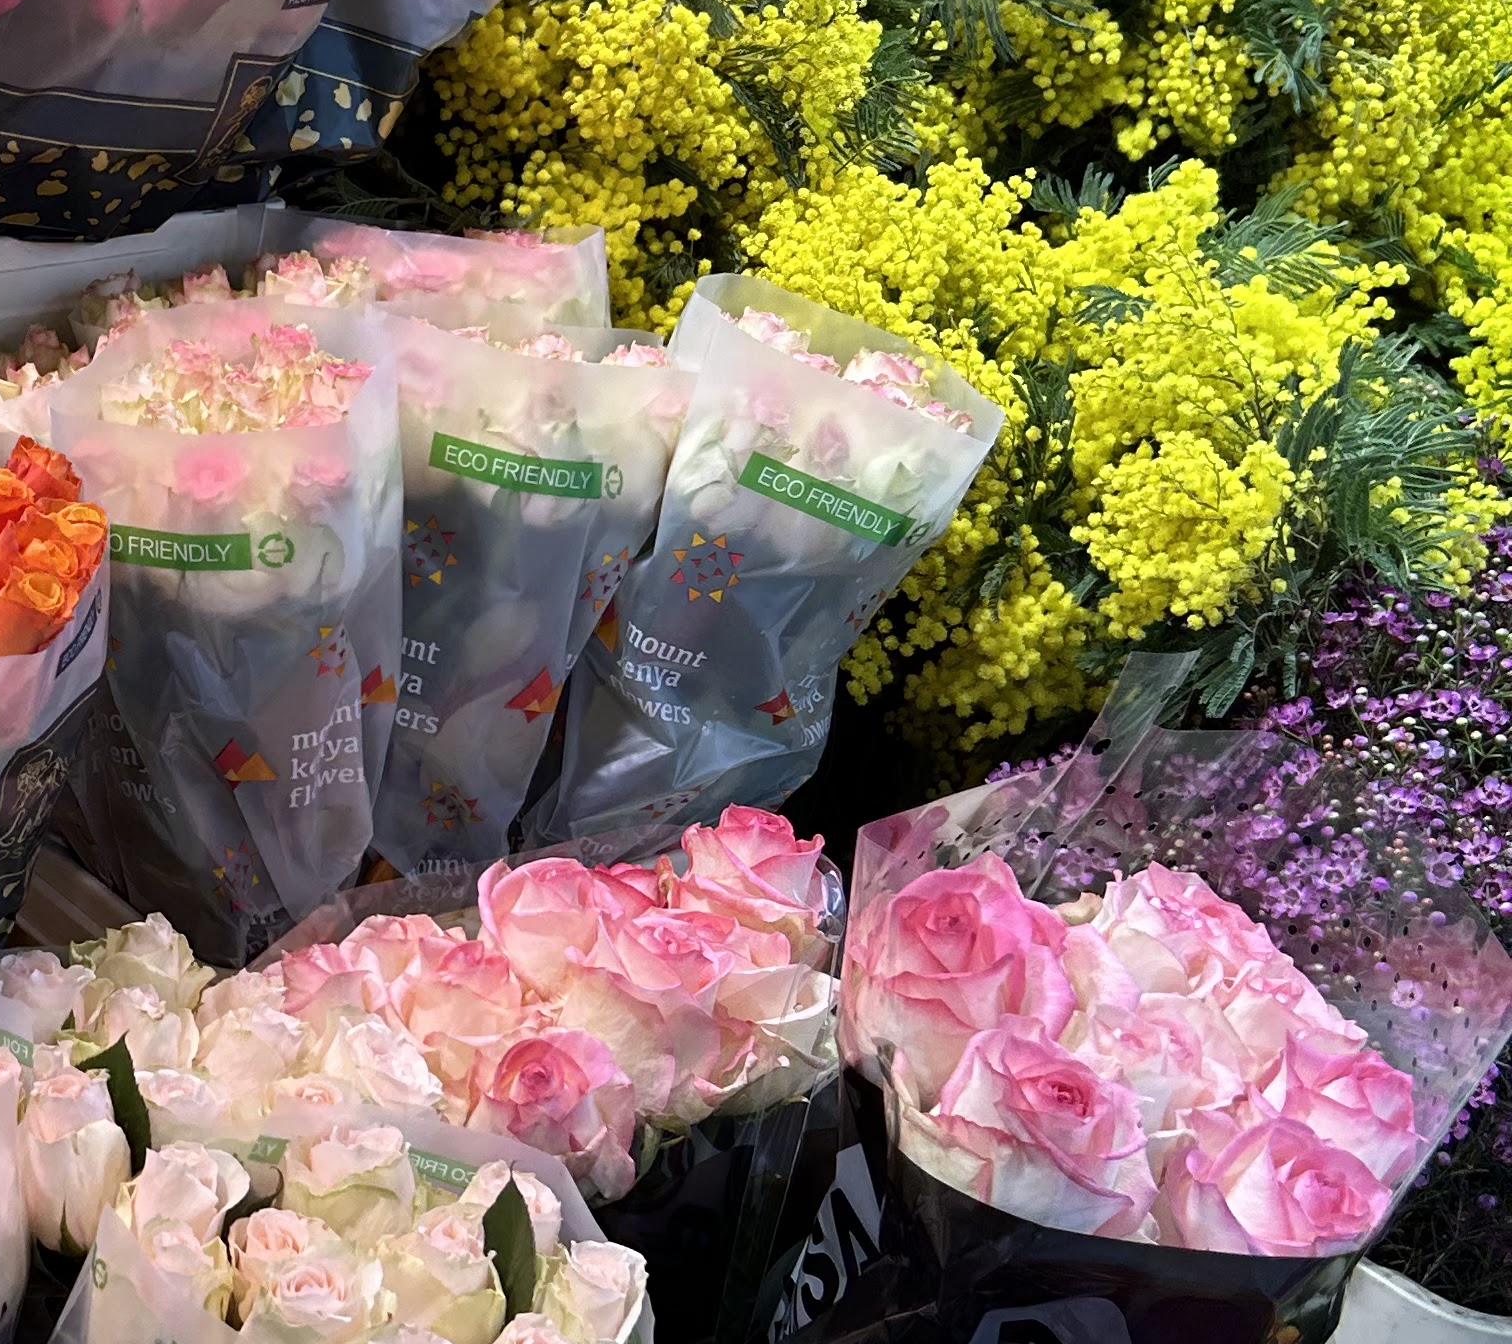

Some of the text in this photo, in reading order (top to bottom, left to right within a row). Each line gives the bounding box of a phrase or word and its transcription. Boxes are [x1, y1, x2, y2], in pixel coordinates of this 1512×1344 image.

[444, 443, 594, 492] ECO FRIENDLY
[757, 465, 902, 538] ECO FRIENDLY
[127, 535, 232, 563] FRIENDLY
[626, 620, 708, 668] mount
